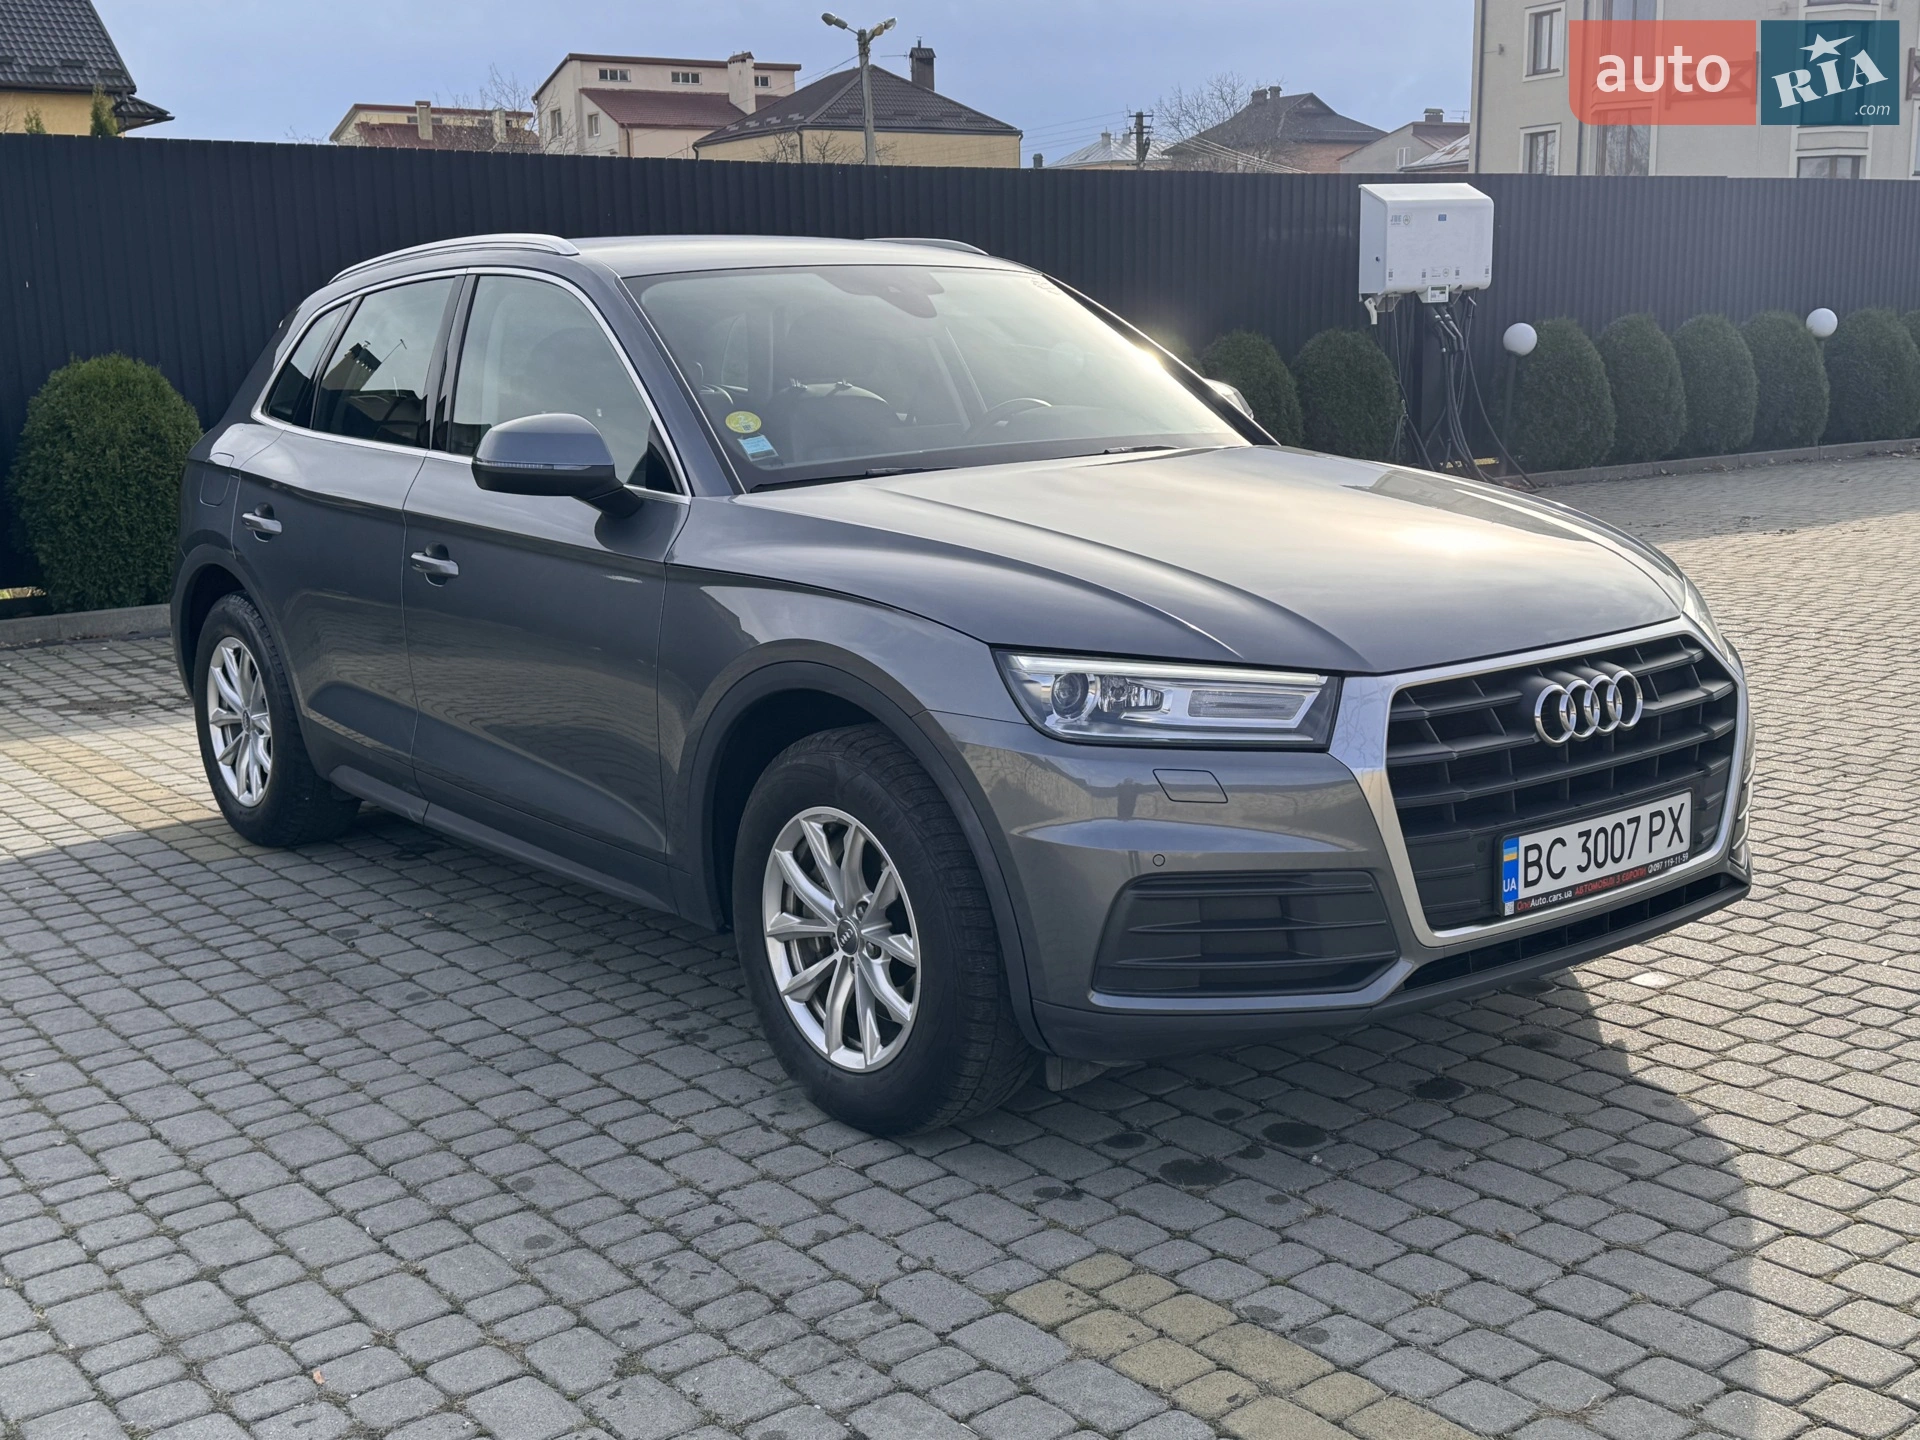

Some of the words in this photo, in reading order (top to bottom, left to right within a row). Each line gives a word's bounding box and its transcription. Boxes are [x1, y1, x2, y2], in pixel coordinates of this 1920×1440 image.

[1524, 837, 1567, 889] BC
[1577, 815, 1641, 873] 3007
[1648, 803, 1684, 853] PX
[1503, 879, 1517, 892] UA
